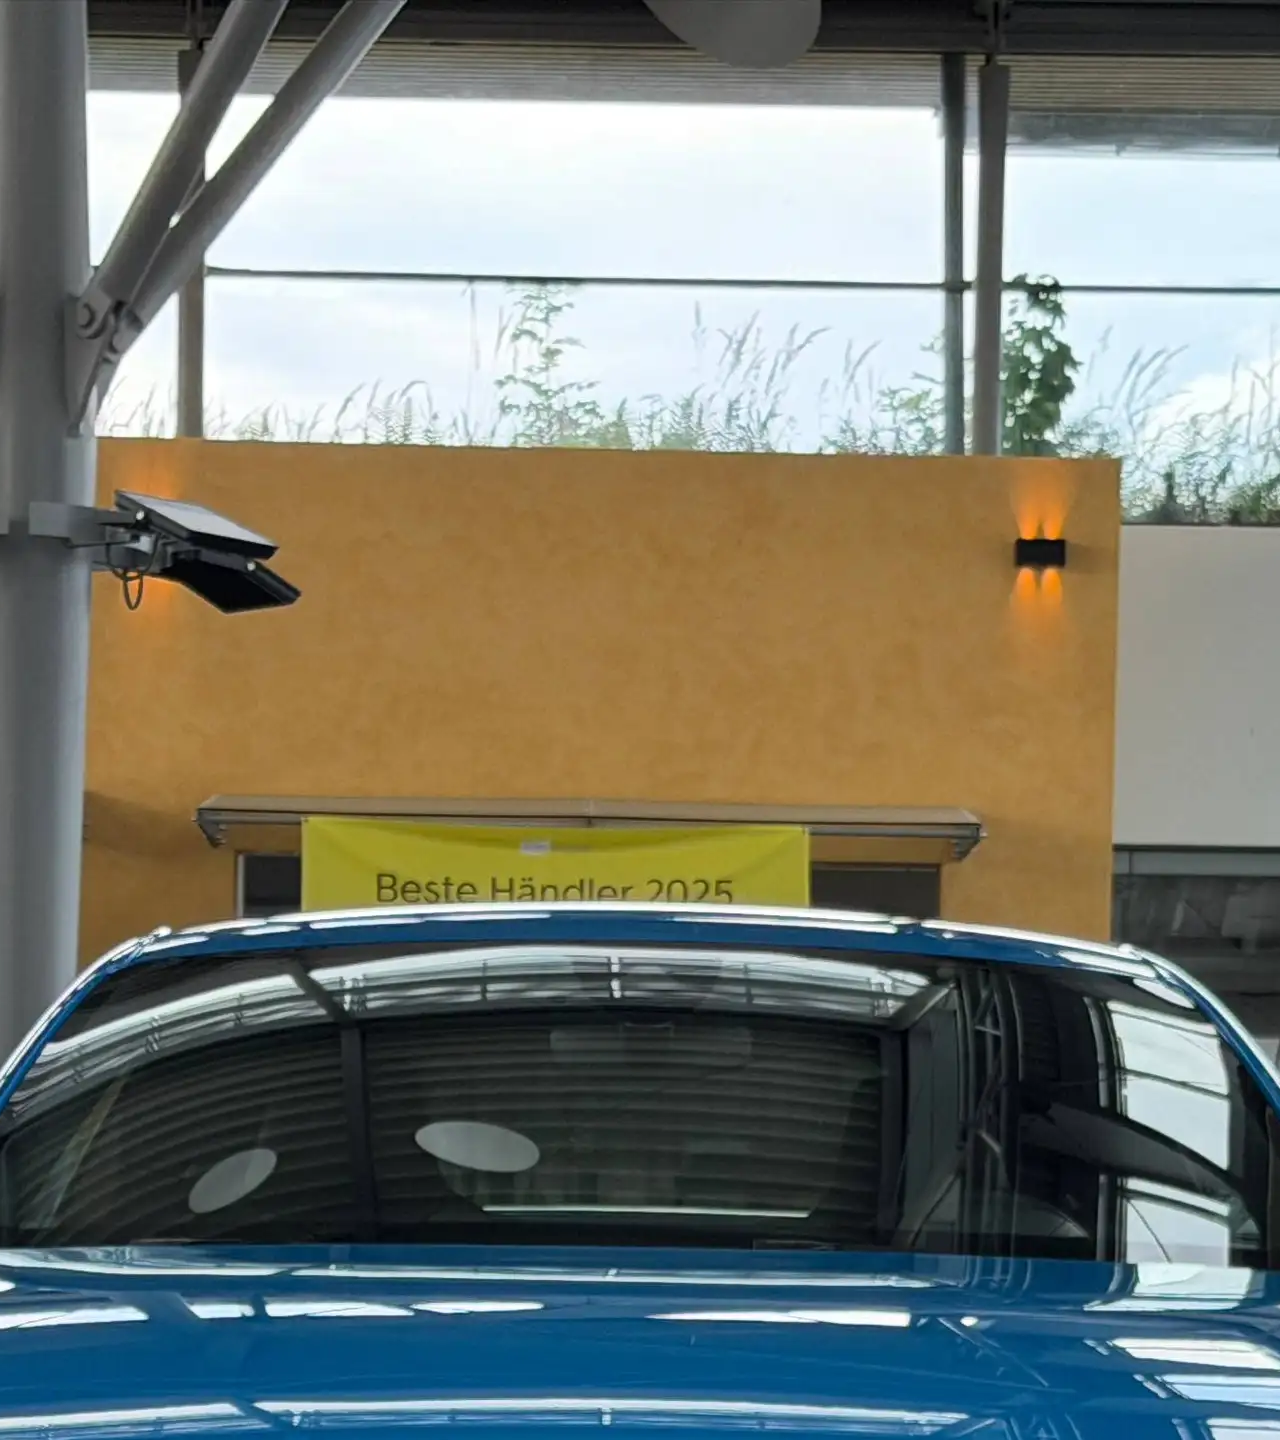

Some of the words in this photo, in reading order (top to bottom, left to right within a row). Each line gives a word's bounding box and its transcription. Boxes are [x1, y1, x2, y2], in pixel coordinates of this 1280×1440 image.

[376, 873, 478, 903] Beste
[491, 875, 634, 902] Händler
[646, 878, 733, 904] 2025
